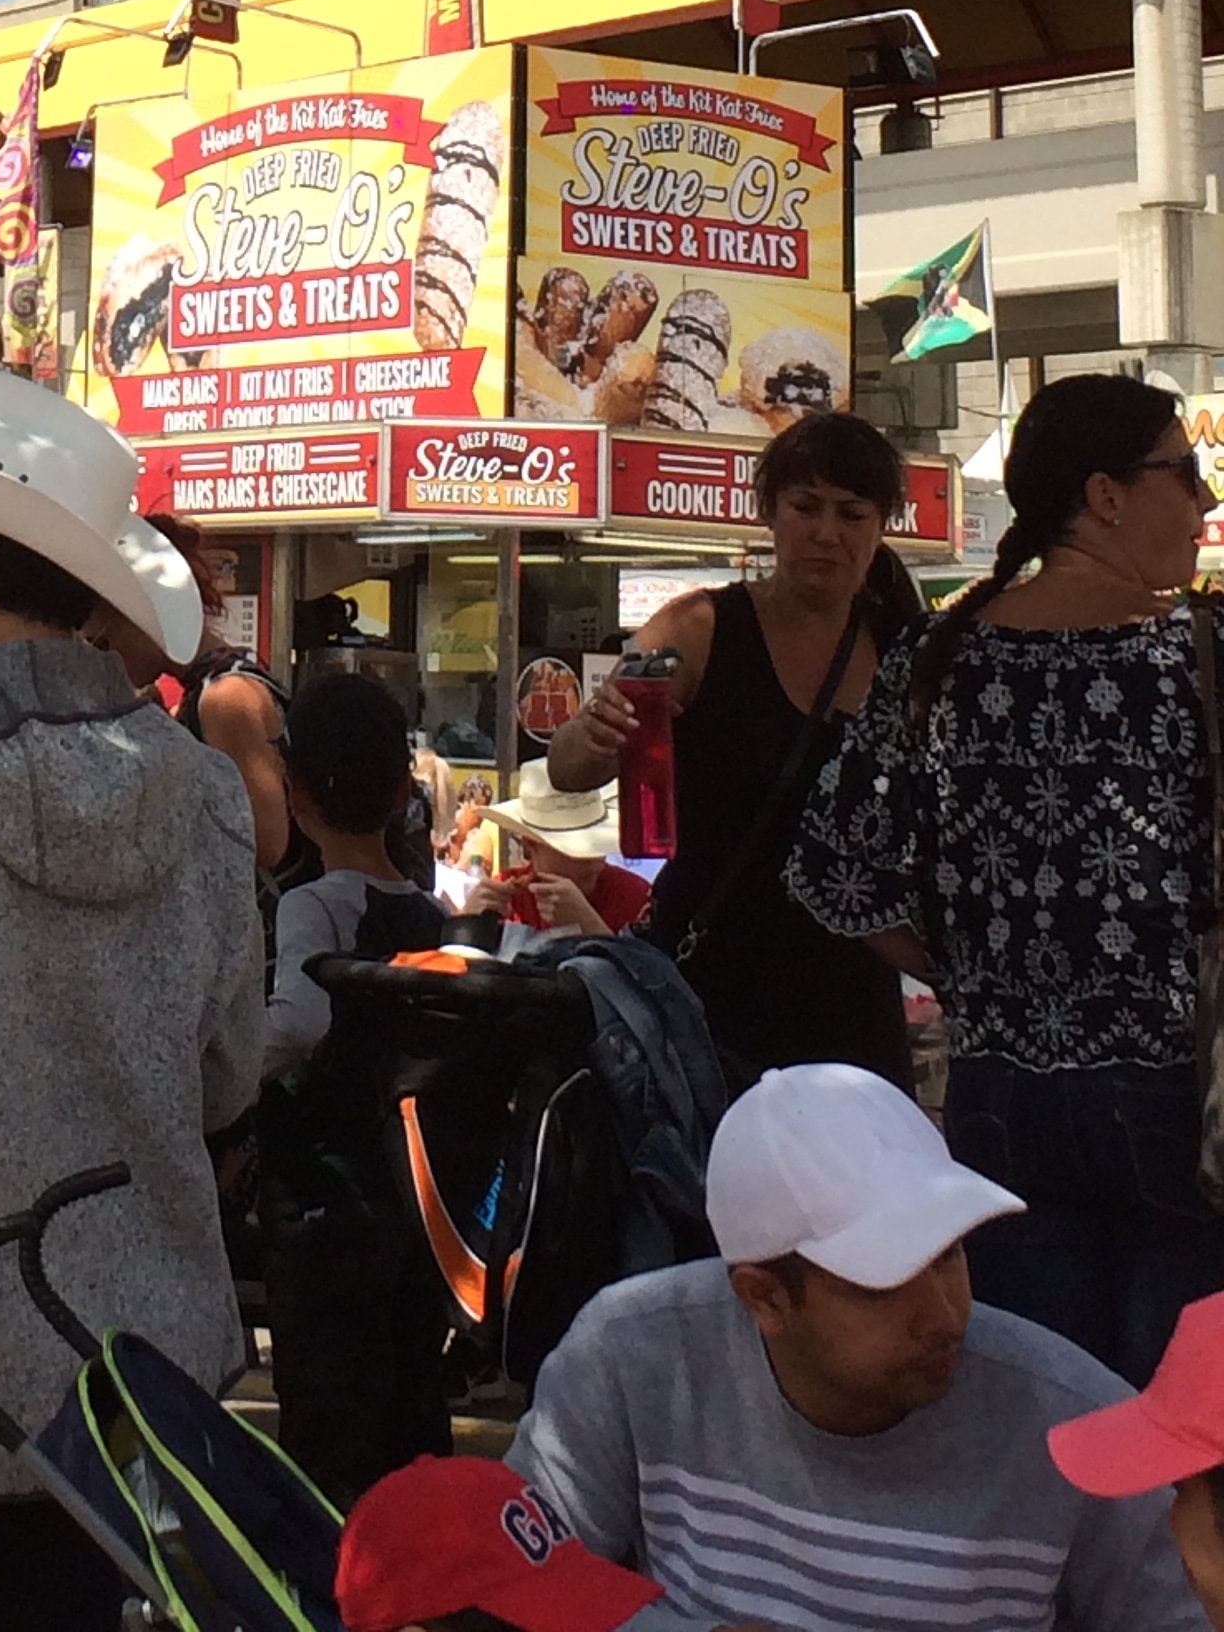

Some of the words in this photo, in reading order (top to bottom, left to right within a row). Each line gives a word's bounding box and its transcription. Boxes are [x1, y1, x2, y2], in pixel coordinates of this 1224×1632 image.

[200, 122, 245, 157] Home
[246, 109, 263, 147] of
[264, 104, 288, 135] the
[291, 99, 317, 132] Kit
[318, 98, 346, 130] Kat
[348, 98, 390, 130] Fries
[590, 84, 638, 108] Home
[641, 86, 657, 113] of
[661, 86, 684, 109] the
[688, 88, 714, 113] Kit
[716, 93, 743, 120] Kat
[744, 101, 785, 133] Fries
[637, 122, 684, 156] DEEP
[688, 124, 741, 167] FRIED
[241, 151, 286, 204] DEEP
[290, 149, 343, 193] FRIED
[560, 127, 810, 230] Steve-O's
[171, 164, 415, 287] Steve-O's
[572, 212, 675, 256] SWEETS
[679, 223, 698, 258] &
[703, 226, 797, 270] TREATS
[178, 284, 274, 337] SWEETS
[278, 282, 297, 327] &
[302, 270, 401, 326] TREATS
[143, 379, 181, 408] MARS
[182, 376, 219, 406] BARS
[239, 371, 263, 401] KIT
[265, 367, 292, 400] KAT
[294, 363, 333, 397] FRIES
[354, 356, 451, 394] CHEESECAKE
[232, 445, 267, 473] DEEP
[267, 442, 306, 471] FRIED
[409, 438, 576, 486] Steve-O's
[458, 432, 490, 451] DEEP
[492, 431, 528, 454] FRIED
[174, 479, 217, 510] MARS
[217, 476, 257, 507] BARS
[258, 478, 270, 505] &
[271, 471, 367, 505] CHEESECAKE
[415, 482, 482, 505] SWEETS
[486, 484, 500, 505] &
[504, 484, 569, 507] TREATS
[647, 480, 725, 518] COOKIE
